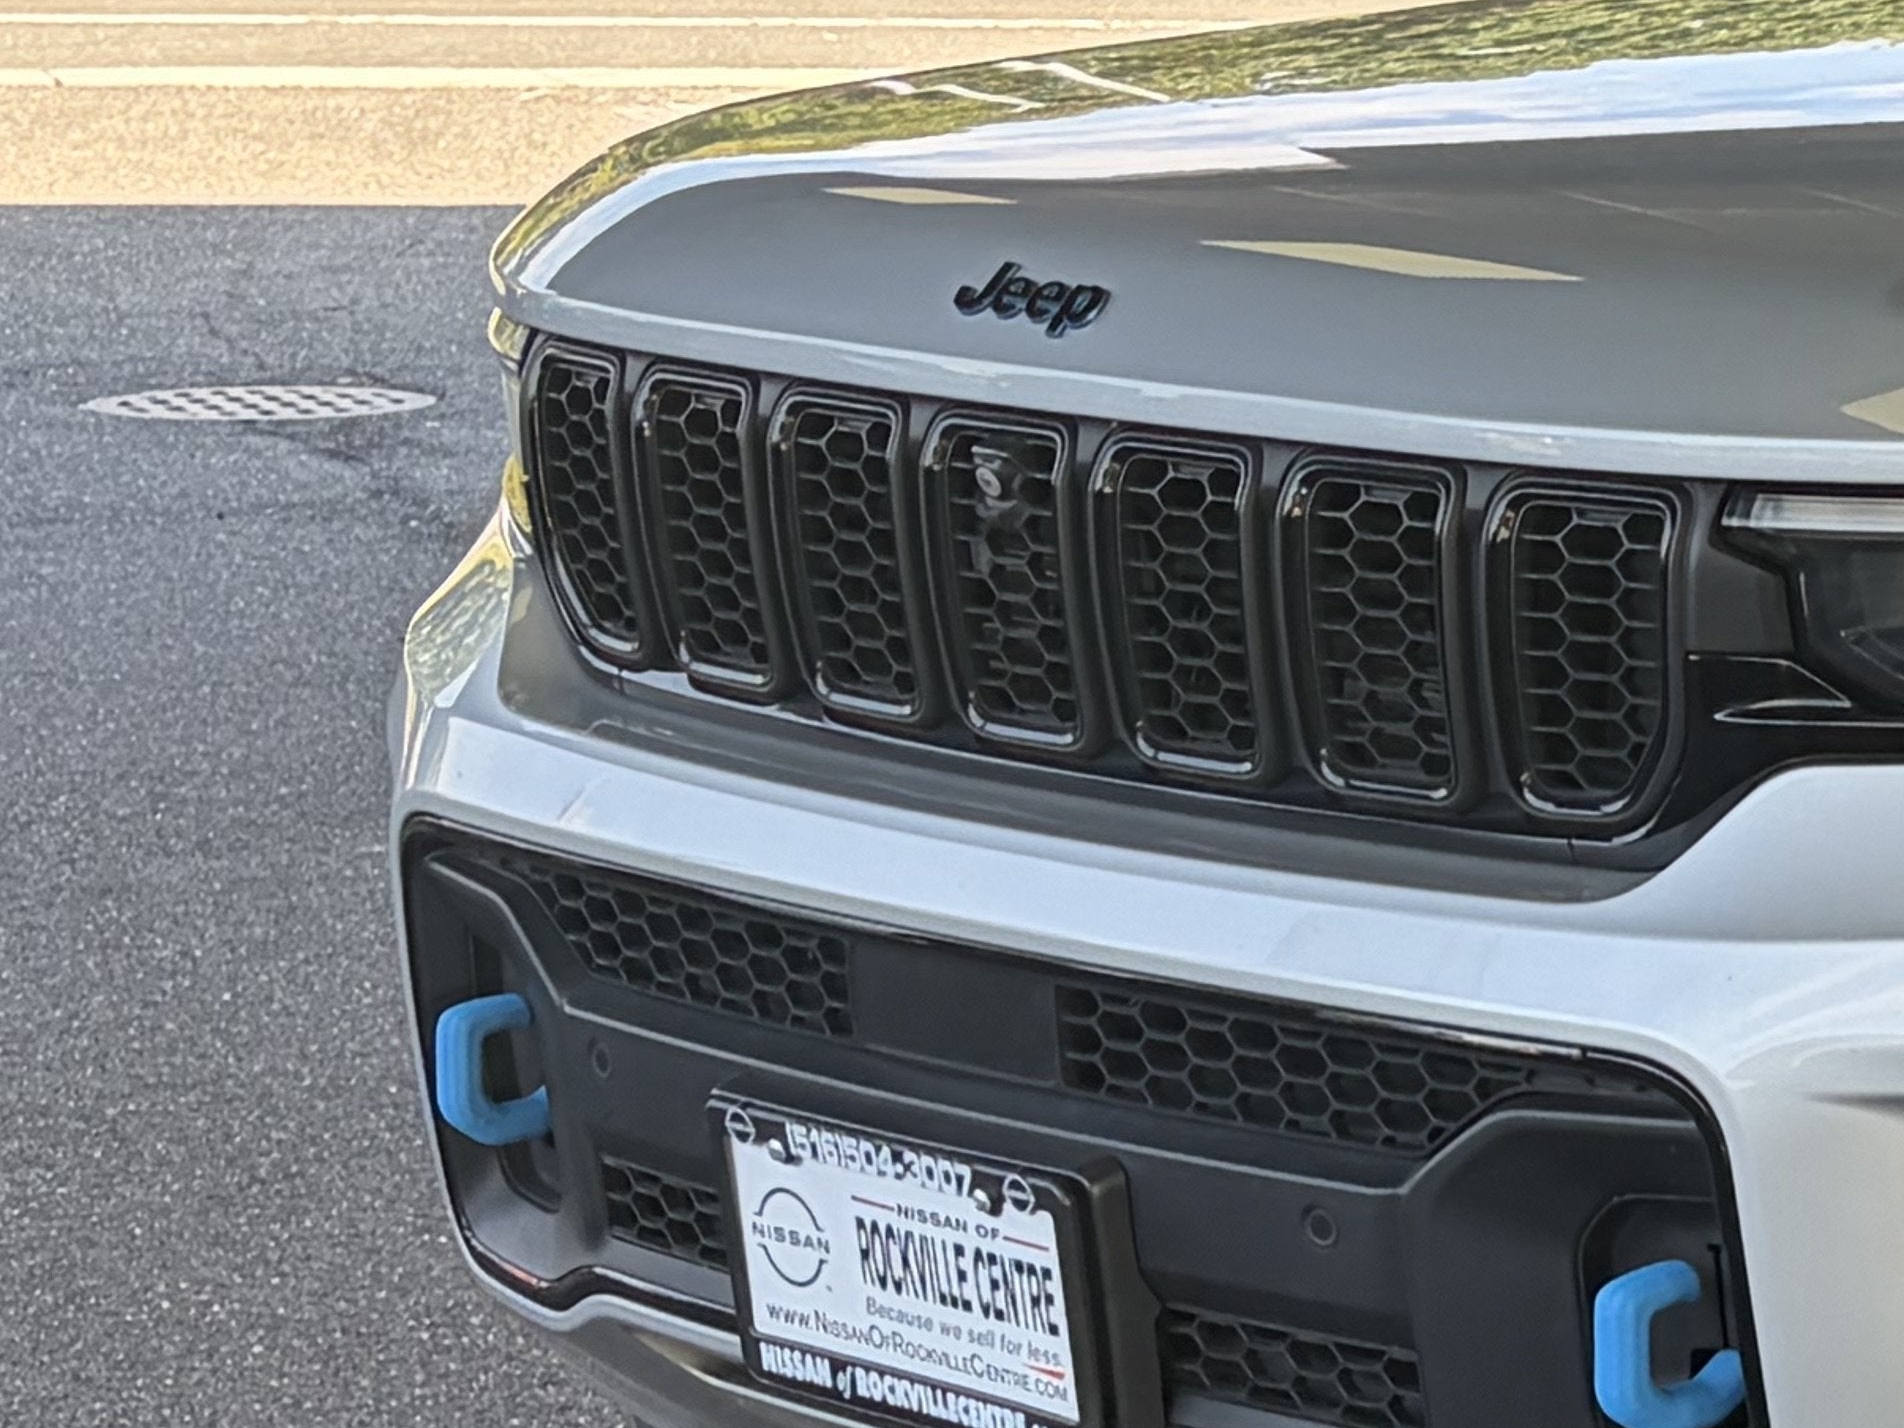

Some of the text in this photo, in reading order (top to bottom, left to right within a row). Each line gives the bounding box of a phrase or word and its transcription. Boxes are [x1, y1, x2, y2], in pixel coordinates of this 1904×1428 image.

[953, 261, 1111, 339] Jeep
[752, 1220, 830, 1254] NISSAN
[896, 1203, 1001, 1242] NISSAN OF
[855, 1215, 1060, 1337] ROCKVILLE CENTRE
[866, 1296, 934, 1333] Because
[938, 1320, 962, 1341] we
[967, 1328, 995, 1350] sell
[1000, 1332, 1022, 1356] for
[759, 1341, 832, 1388] NISSAN
[836, 1364, 853, 1400] of
